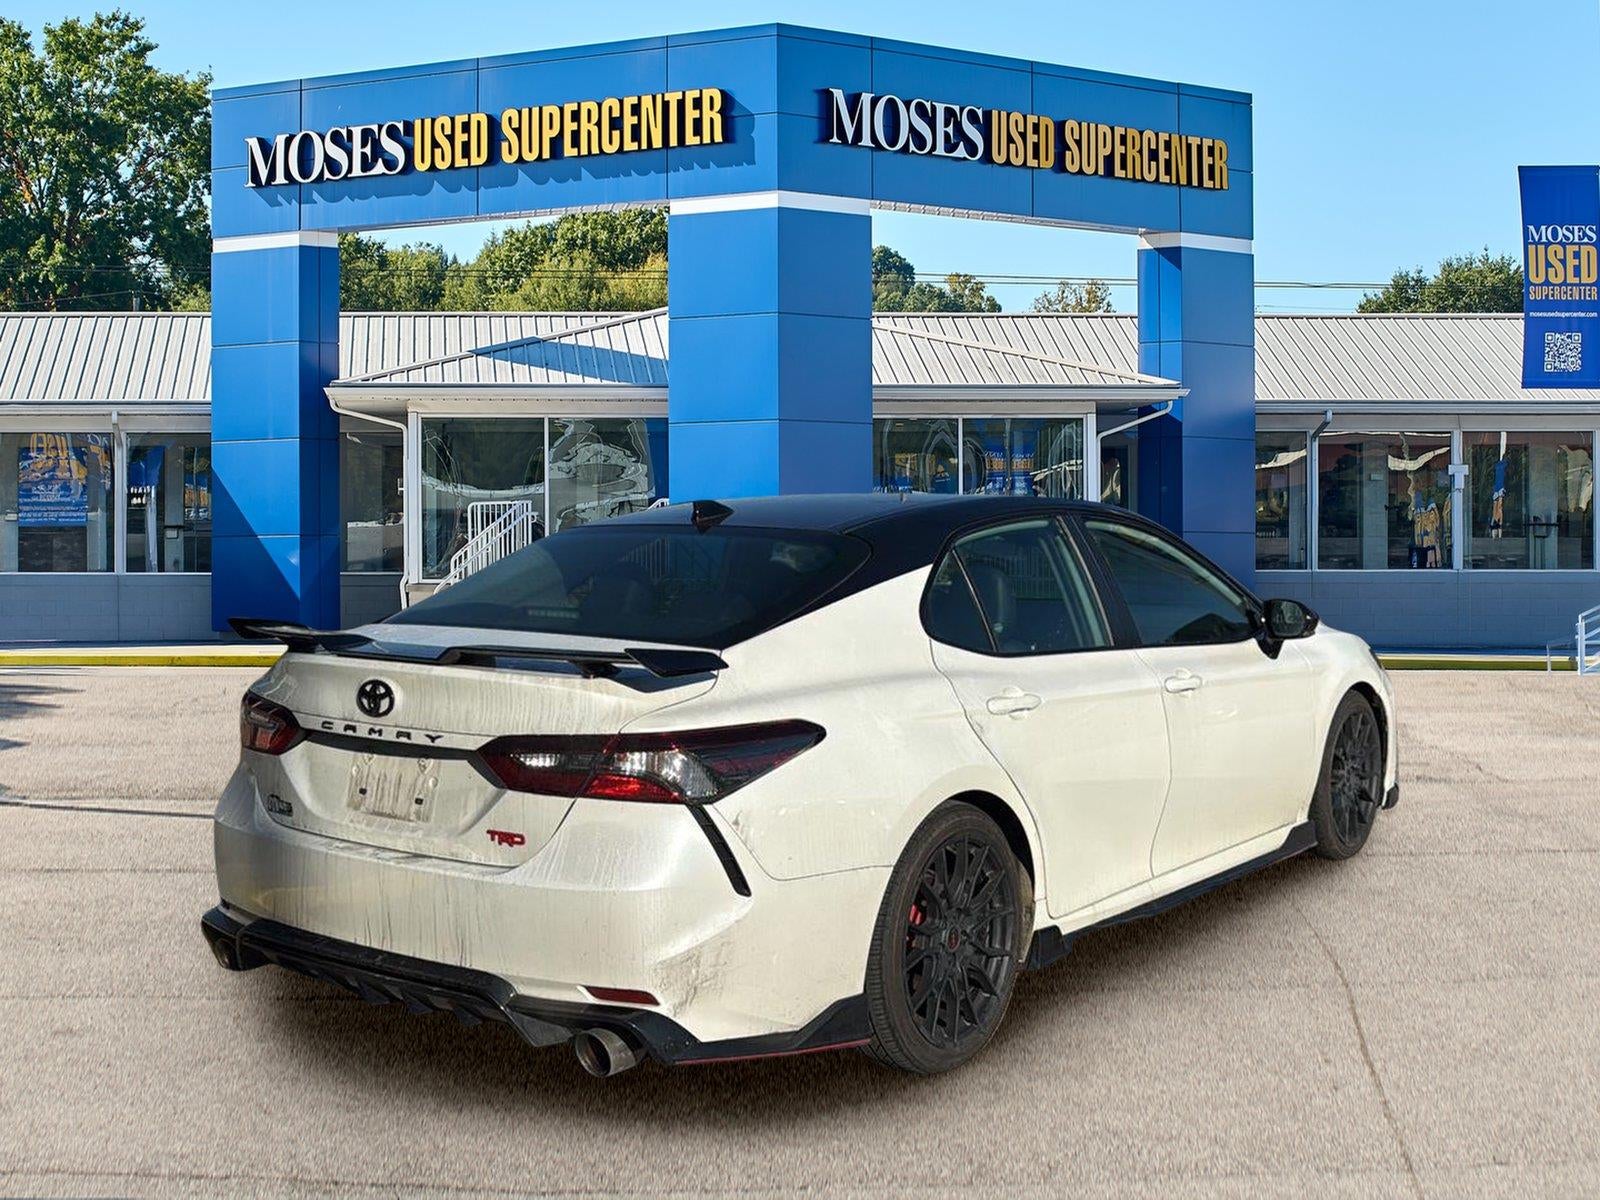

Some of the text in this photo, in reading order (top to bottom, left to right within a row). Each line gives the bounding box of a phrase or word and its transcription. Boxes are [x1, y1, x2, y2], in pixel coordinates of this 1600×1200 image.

[244, 87, 724, 188] MOSES USED SUPERCENTER
[828, 87, 1229, 190] MOSES USED SUPERCENTER
[1527, 224, 1597, 244] MOSES
[1528, 244, 1598, 285] USED
[1529, 285, 1598, 300] SUPERCENTER
[321, 720, 444, 744] CAMRY
[486, 829, 526, 848] TRD
